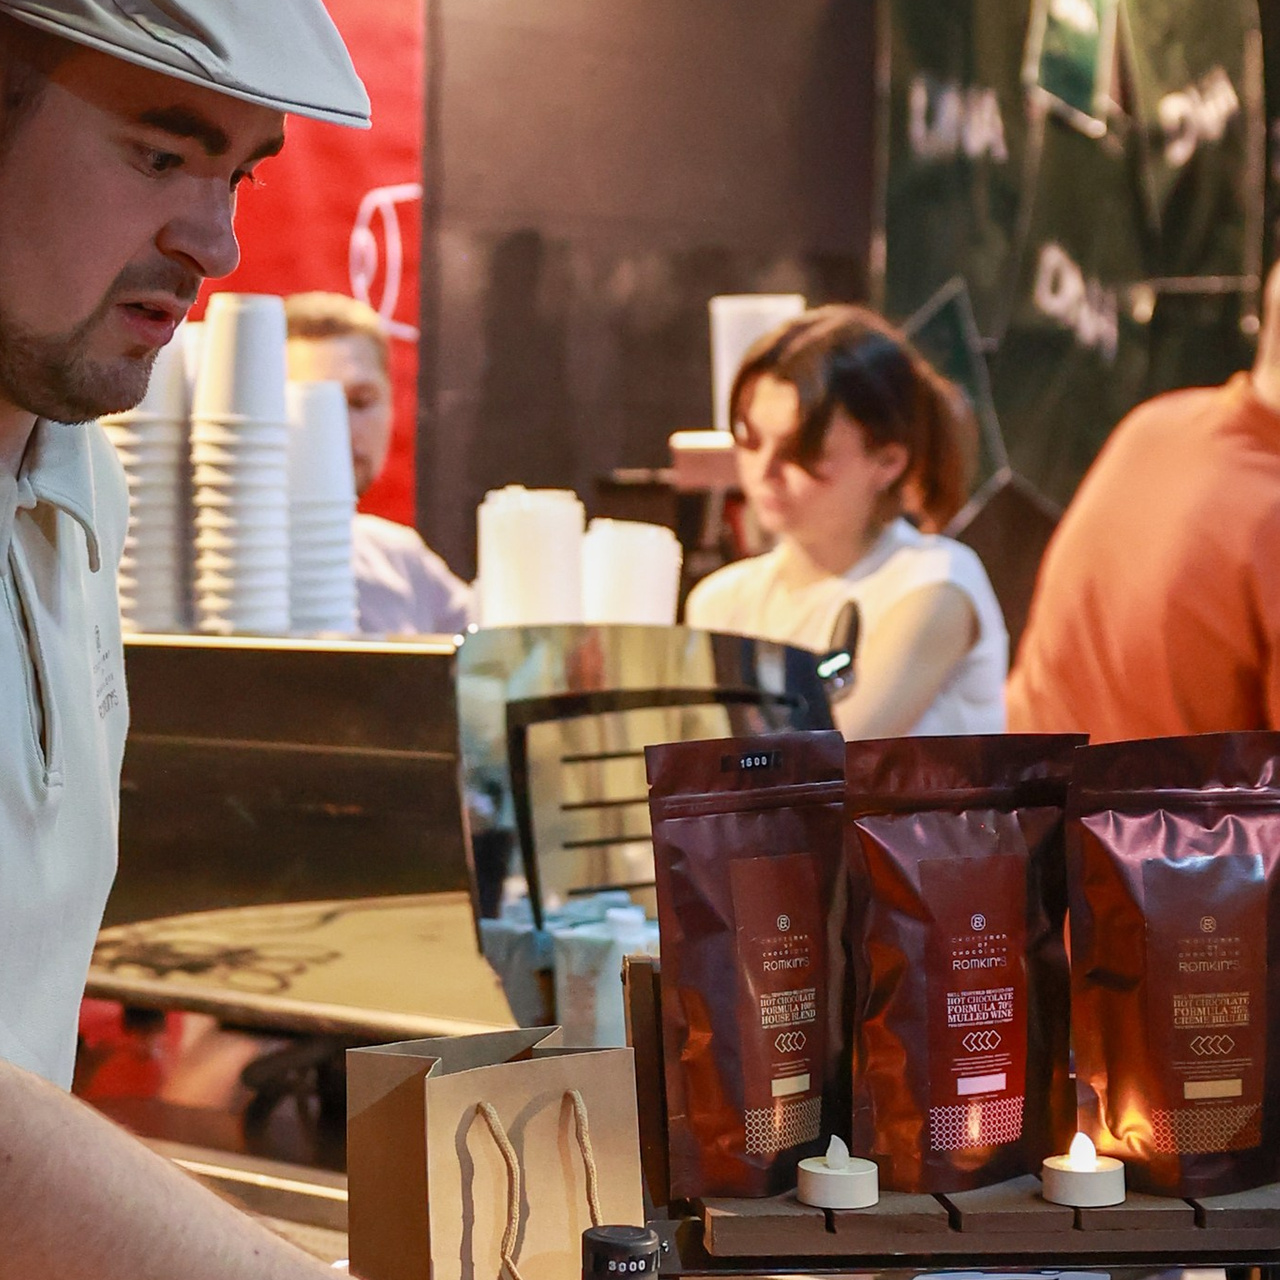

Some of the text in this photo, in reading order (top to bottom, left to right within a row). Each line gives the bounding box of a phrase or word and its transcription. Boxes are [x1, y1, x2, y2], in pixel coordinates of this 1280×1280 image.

[760, 997, 776, 1007] HOT
[777, 992, 815, 1005] CHOCOLATE
[947, 992, 1013, 1005] HOT CHOCOLATE
[761, 1003, 799, 1015] FORMULA
[947, 1001, 1013, 1015] FORMULA 70%
[761, 1013, 790, 1025] HOUSE
[791, 1009, 816, 1021] BLEND
[948, 1012, 989, 1023] MULLED
[990, 1008, 1013, 1019] WINE
[608, 1259, 646, 1272] 3000
